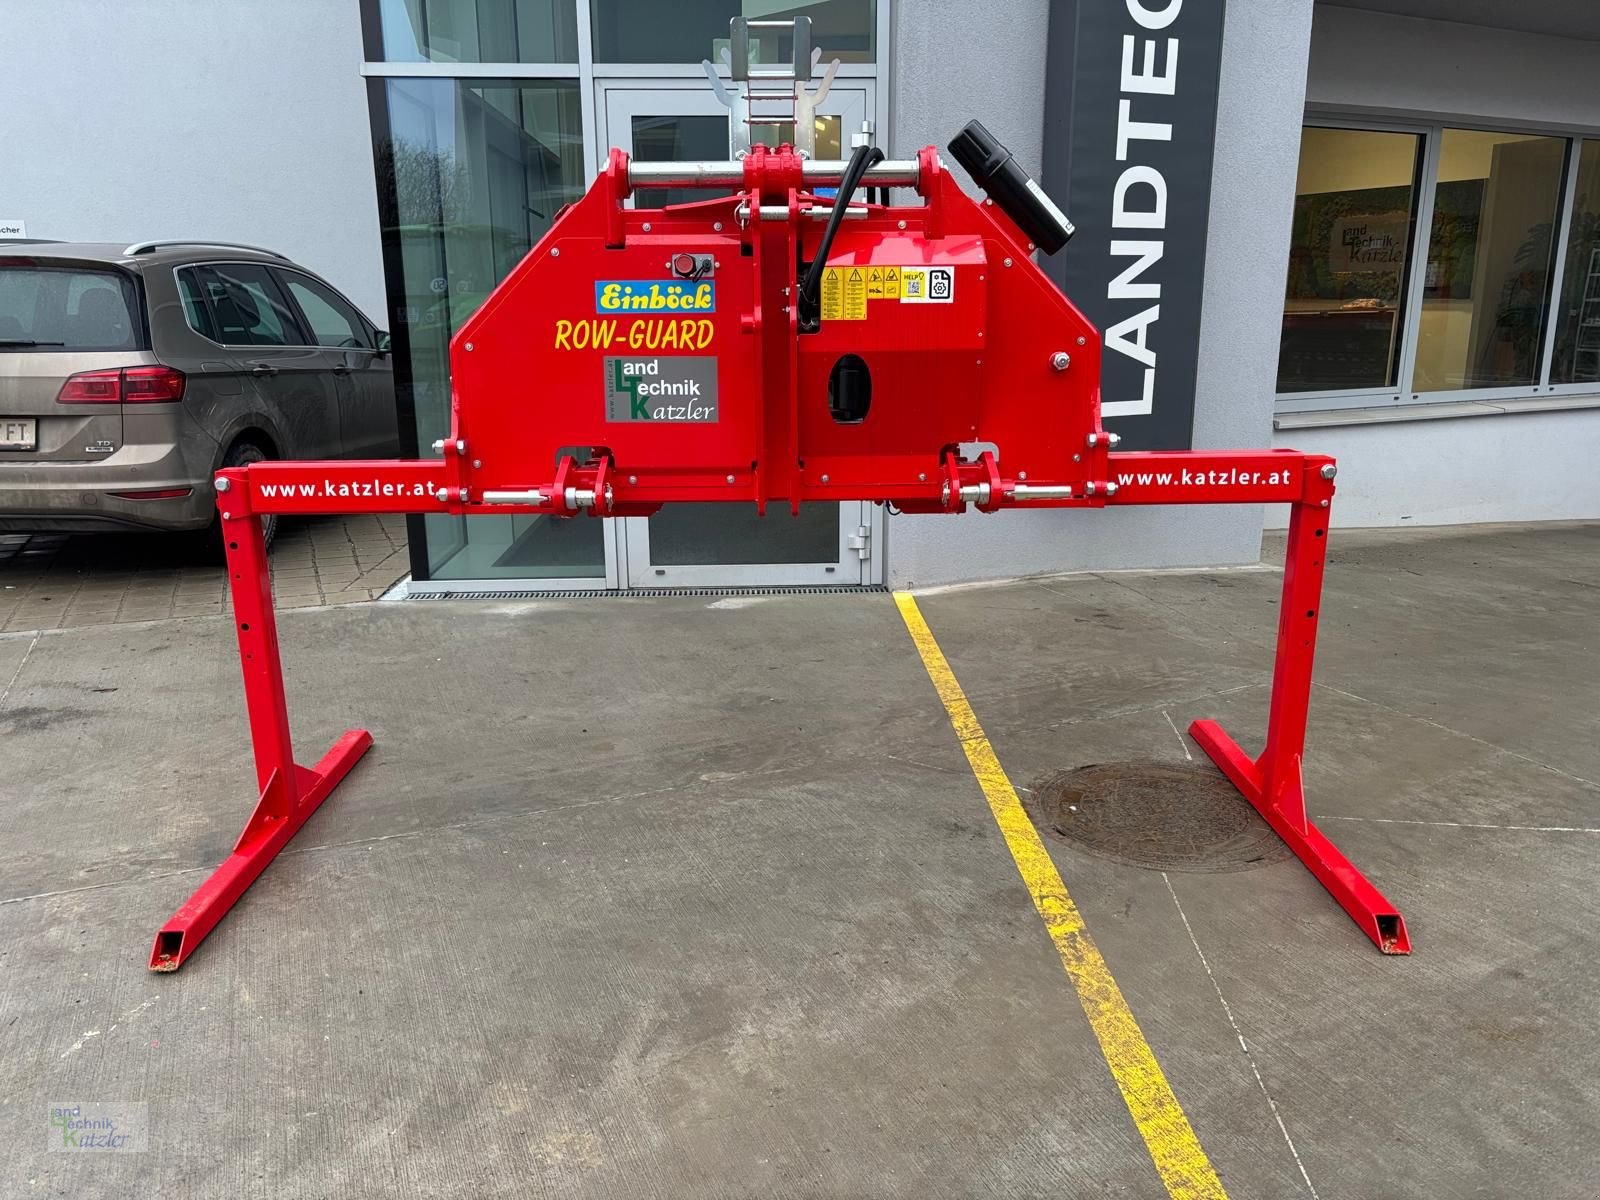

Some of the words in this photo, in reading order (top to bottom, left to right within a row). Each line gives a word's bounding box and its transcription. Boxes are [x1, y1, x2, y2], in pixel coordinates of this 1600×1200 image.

[0, 226, 20, 234] cher
[1351, 241, 1403, 264] Katzle
[600, 284, 712, 310] Einböck
[555, 319, 714, 351] ROW-GUARD
[615, 359, 660, 392] Land
[624, 376, 701, 400] Technik
[631, 396, 715, 420] Katzler
[0, 423, 27, 441] FT
[260, 480, 435, 497] www.katzler.at
[1118, 468, 1291, 486] www.katzler.at
